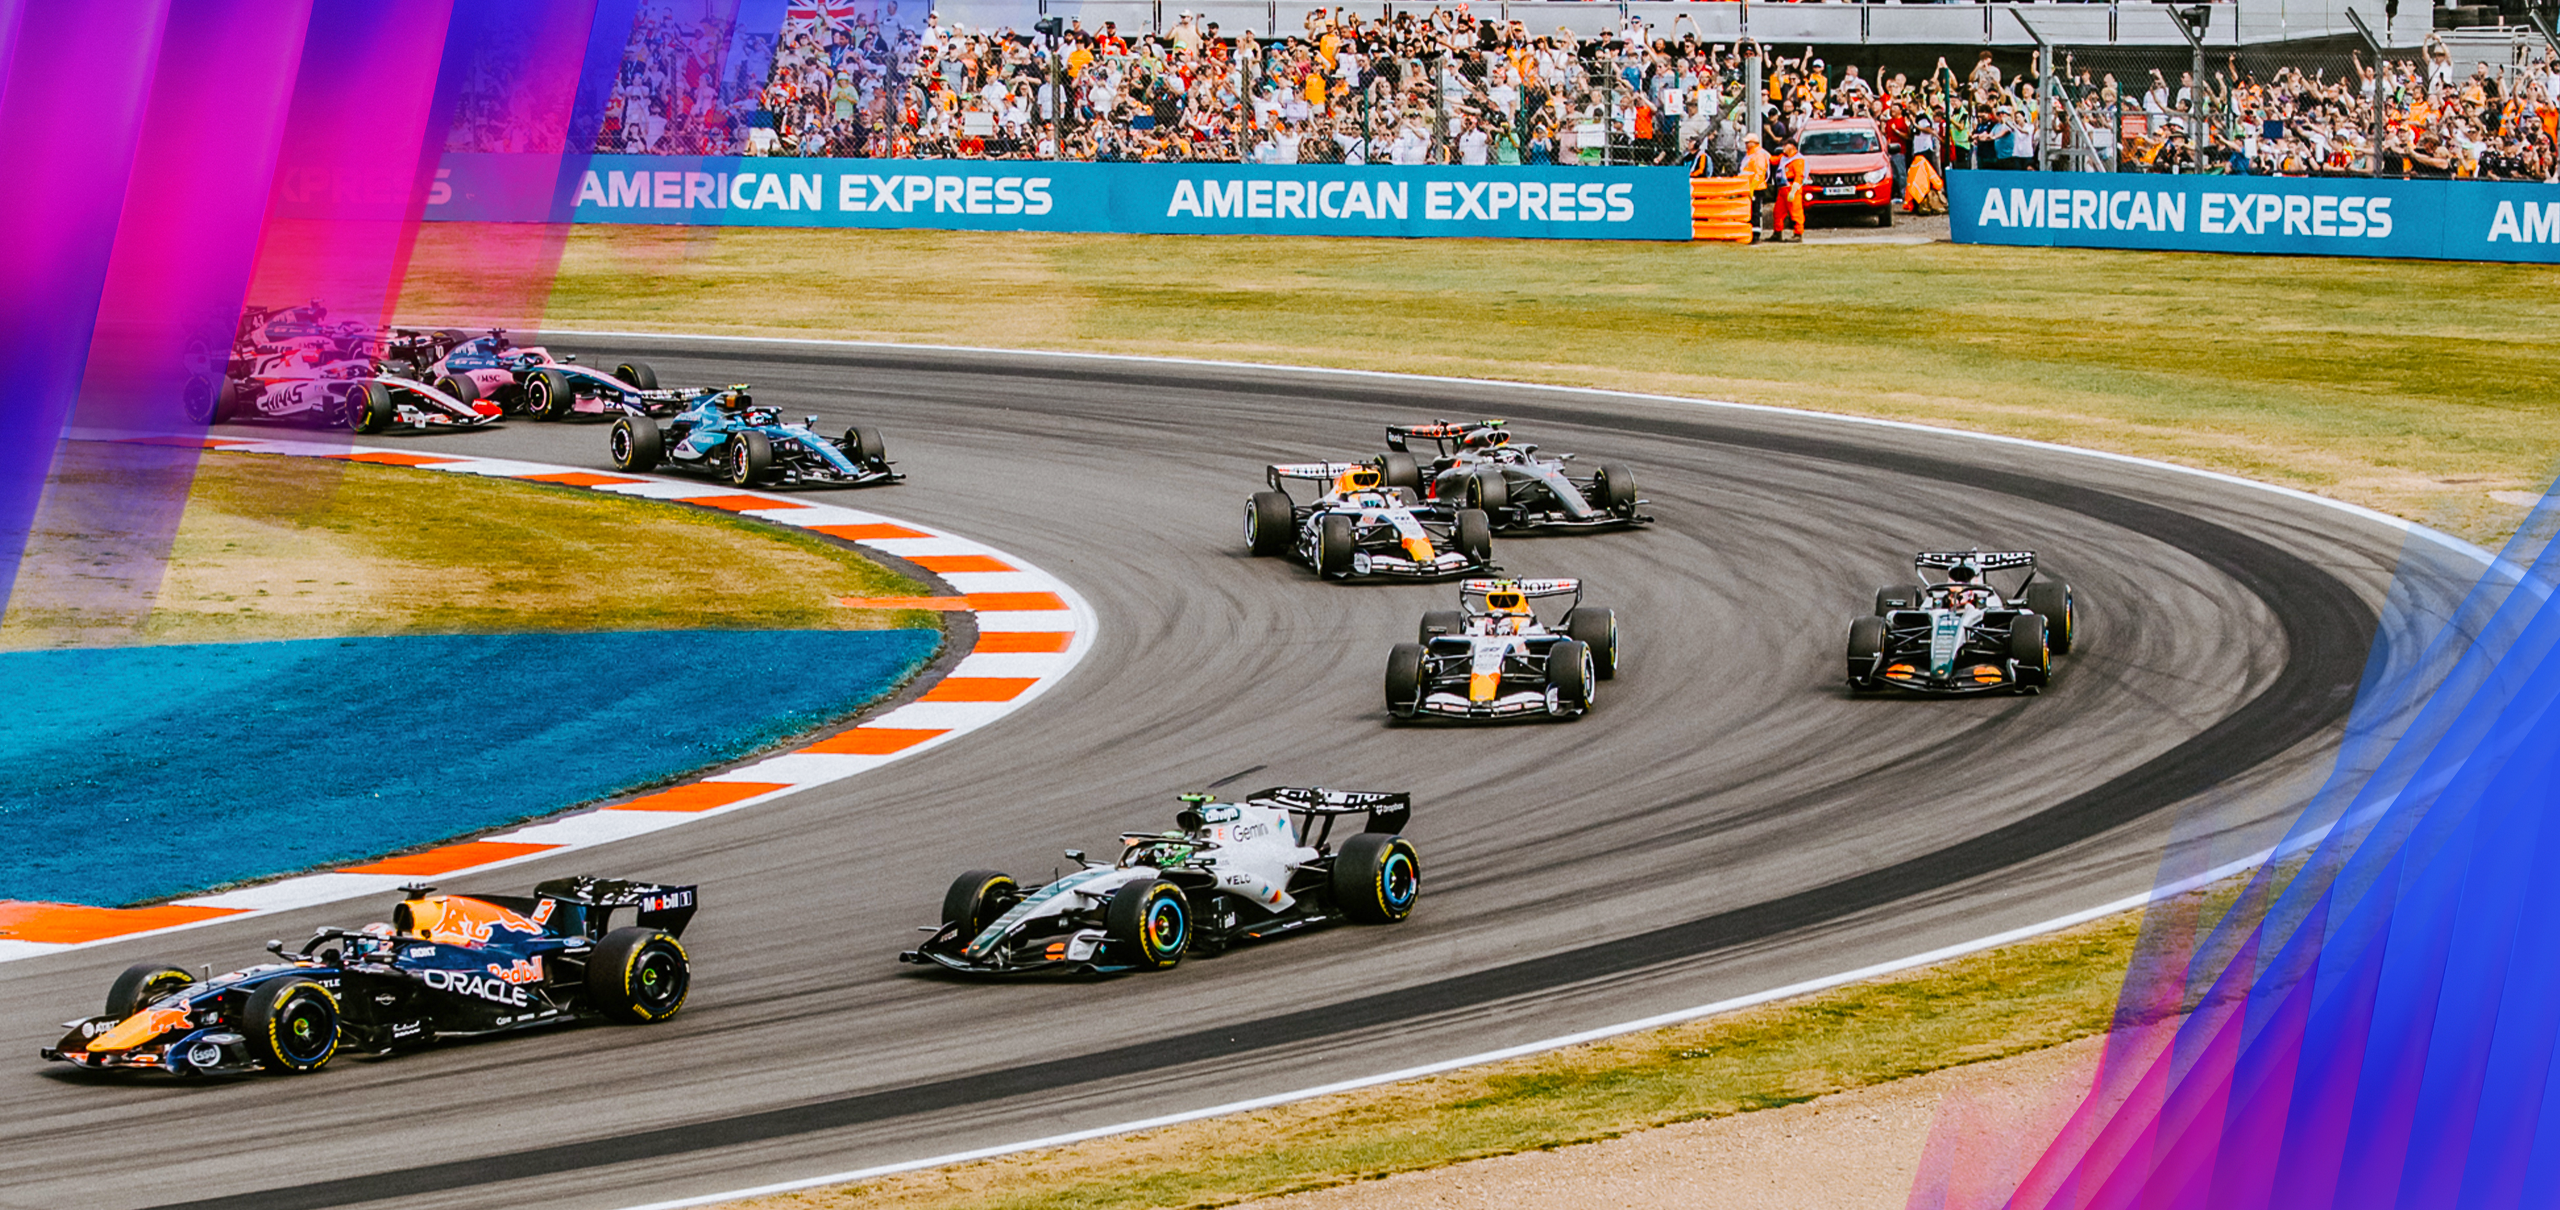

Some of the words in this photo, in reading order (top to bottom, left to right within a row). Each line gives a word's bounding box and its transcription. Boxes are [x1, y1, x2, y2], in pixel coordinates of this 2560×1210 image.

[278, 166, 452, 206] XPRESS
[570, 169, 822, 211] AMERICAN
[839, 174, 1053, 215] EXPRESS
[1166, 179, 1408, 220] AMERICAN
[1425, 181, 1635, 222] EXPRESS
[1978, 187, 2186, 232] AMERICAN
[2199, 192, 2393, 238] EXPRESS
[2487, 200, 2560, 244] AM
[481, 374, 501, 382] MSC
[261, 383, 309, 411] HAAS
[1225, 873, 1251, 886] VELO
[643, 893, 679, 913] Mobil
[409, 945, 436, 959] ROKT
[487, 958, 520, 985] Red
[520, 955, 544, 984] Bull
[424, 968, 528, 1008] ORACLE
[193, 1048, 216, 1061] Esso
